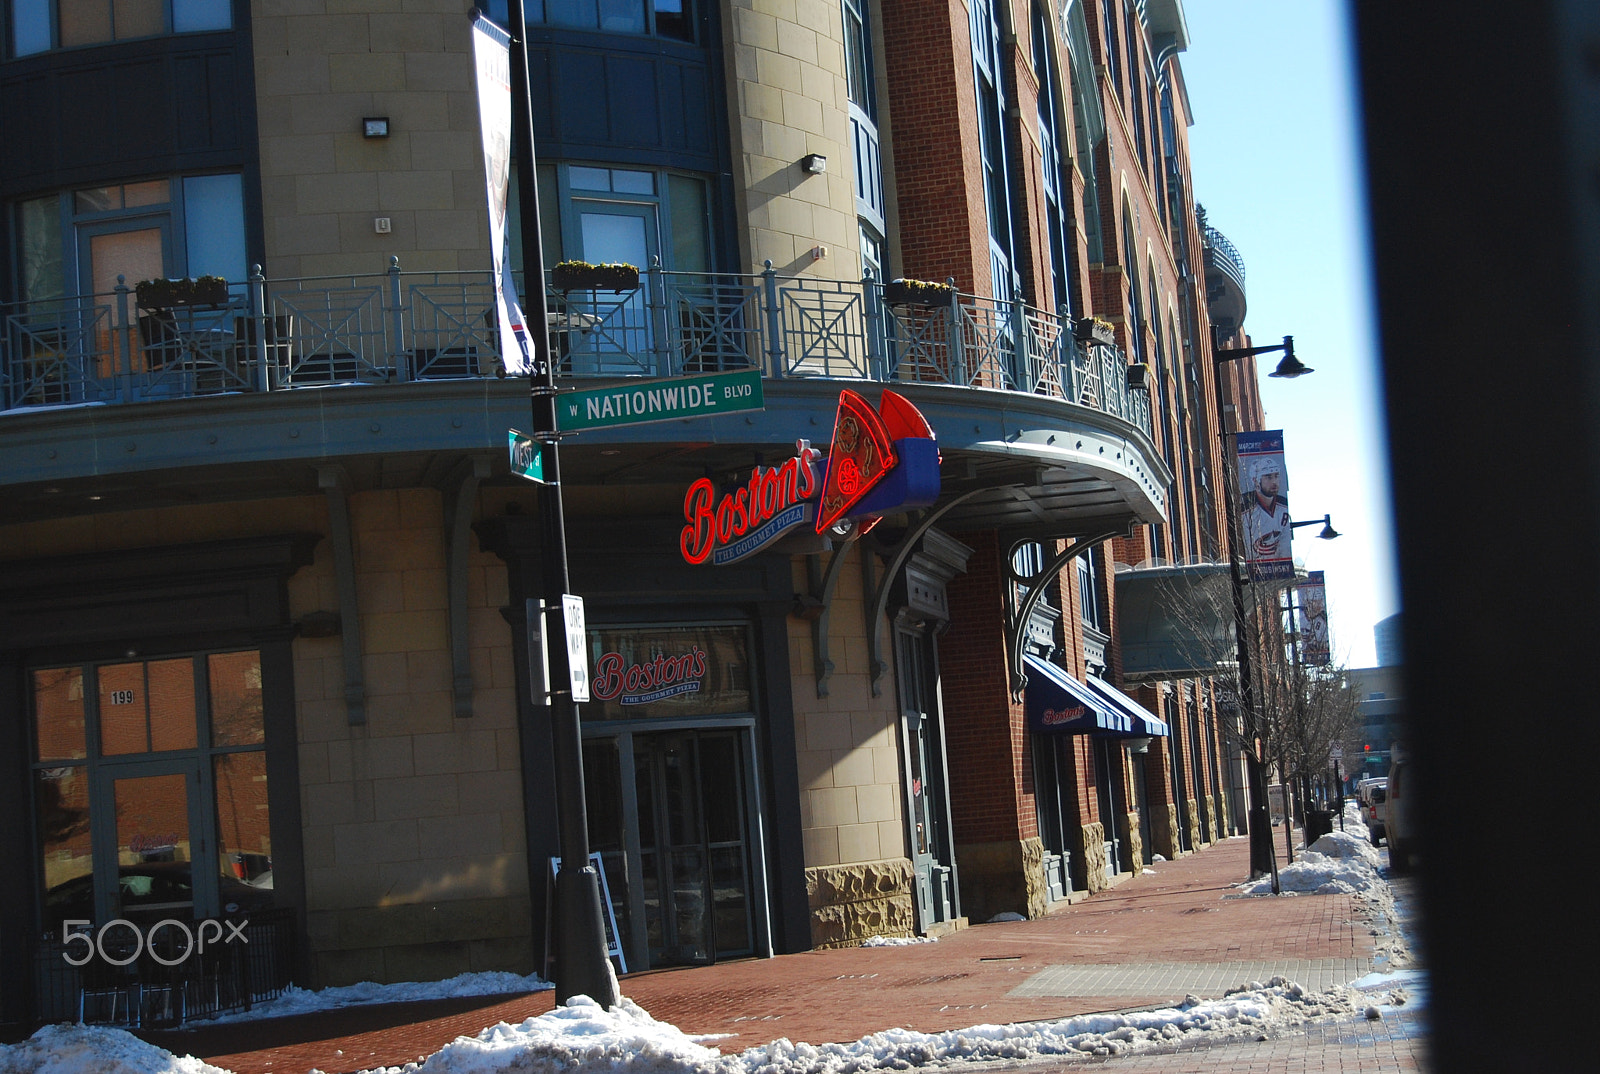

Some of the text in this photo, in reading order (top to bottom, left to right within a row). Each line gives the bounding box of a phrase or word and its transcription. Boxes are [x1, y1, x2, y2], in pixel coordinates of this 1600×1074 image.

[570, 383, 752, 420] W NATIONWIDE BLVD
[681, 438, 821, 565] Boston's
[717, 508, 802, 562] THE GOURMET PIZZA
[568, 606, 583, 628] ONE
[570, 633, 584, 656] WAY
[592, 645, 706, 700] Boston's
[112, 690, 132, 704] 199
[641, 688, 674, 701] GOURMET
[677, 683, 697, 693] PIZZA
[1042, 705, 1085, 725] Boston's
